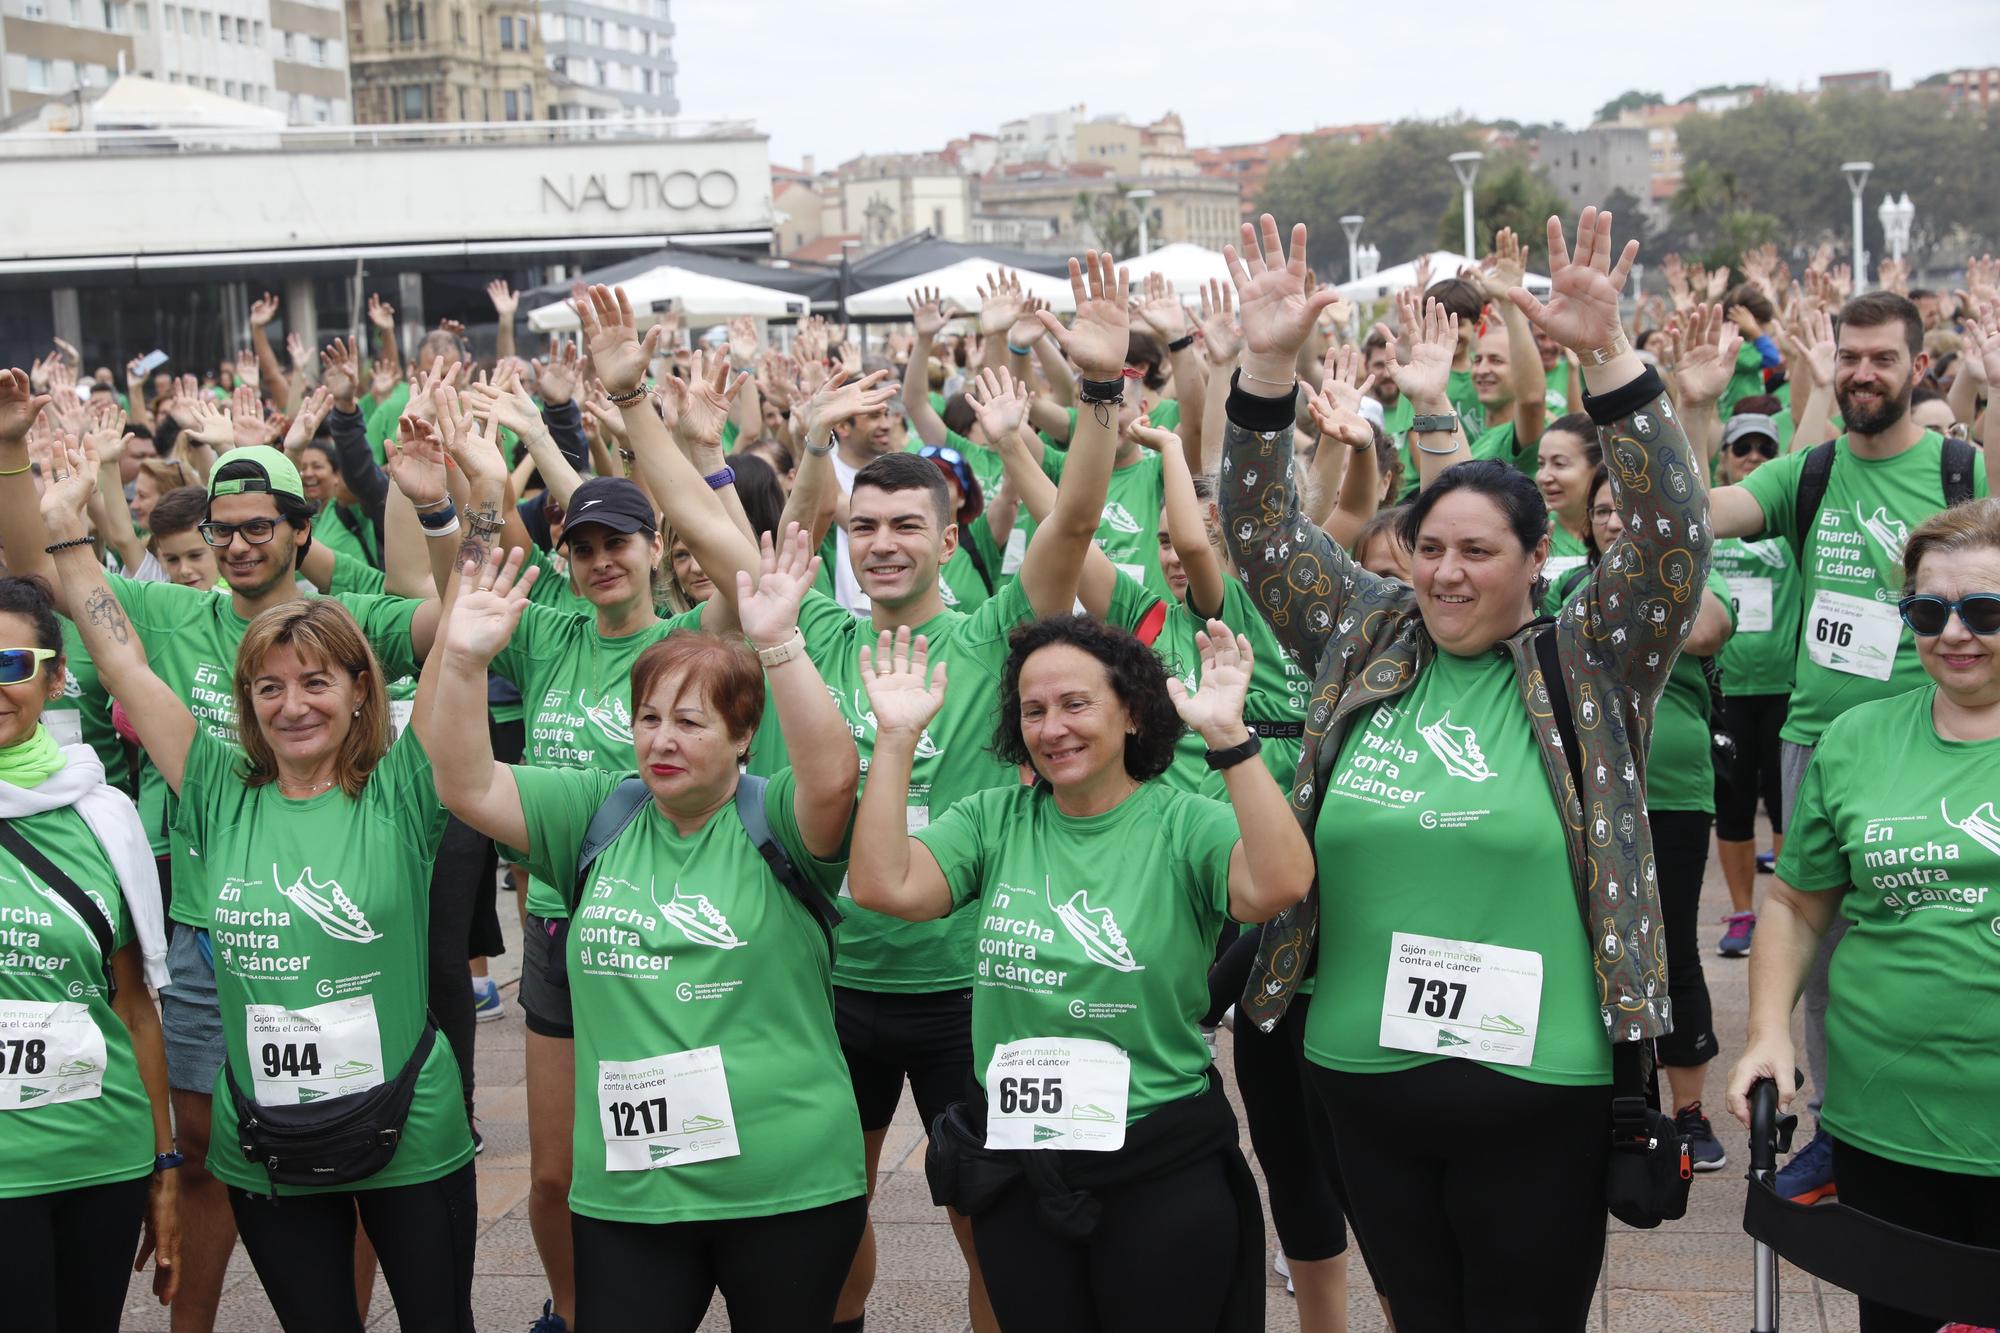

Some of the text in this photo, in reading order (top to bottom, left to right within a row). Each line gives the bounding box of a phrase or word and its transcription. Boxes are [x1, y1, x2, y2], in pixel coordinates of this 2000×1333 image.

[538, 168, 739, 213] NAUTICO
[1820, 511, 1840, 526] En
[1816, 545, 1860, 561] contra
[1826, 561, 1876, 579] cáncer
[1816, 618, 1853, 647] 616
[194, 667, 218, 686] En
[543, 693, 562, 708] En
[1288, 694, 1305, 708] el
[533, 742, 595, 762] el cáncer
[1350, 775, 1426, 803] cáncer
[1864, 824, 1893, 844] En
[1864, 841, 1959, 868] marcha
[1872, 867, 1949, 889] contra
[218, 882, 241, 902] En
[592, 881, 613, 899] En
[1883, 892, 1905, 907] el
[215, 907, 291, 927] marcha
[582, 904, 657, 932] marcha
[216, 929, 280, 950] contra
[580, 925, 641, 946] contra
[581, 947, 673, 971] el cáncer
[979, 938, 1036, 960] contra
[1401, 944, 1482, 963] Gijón en marcha
[238, 951, 311, 972] cáncer
[1399, 956, 1432, 968] contra
[1434, 960, 1444, 968] el
[1446, 962, 1482, 974] cáncer
[978, 958, 1068, 986] el cáncer
[1408, 977, 1467, 1020] 737
[10, 1020, 20, 1028] el
[254, 1014, 275, 1024] Gijón
[254, 1025, 280, 1033] contra
[0, 1039, 46, 1075] 78
[262, 1043, 322, 1077] 944
[997, 1058, 1024, 1068] contra
[1026, 1058, 1035, 1066] el
[1037, 1058, 1070, 1067] cáncer
[1001, 1050, 1019, 1060] Gijón
[1034, 1048, 1071, 1057] marcha
[604, 1071, 621, 1082] Gijón
[628, 1067, 665, 1080] marcha
[604, 1078, 667, 1091] contra el cáncer
[1000, 1077, 1063, 1114] 655
[608, 1097, 668, 1137] 1217
